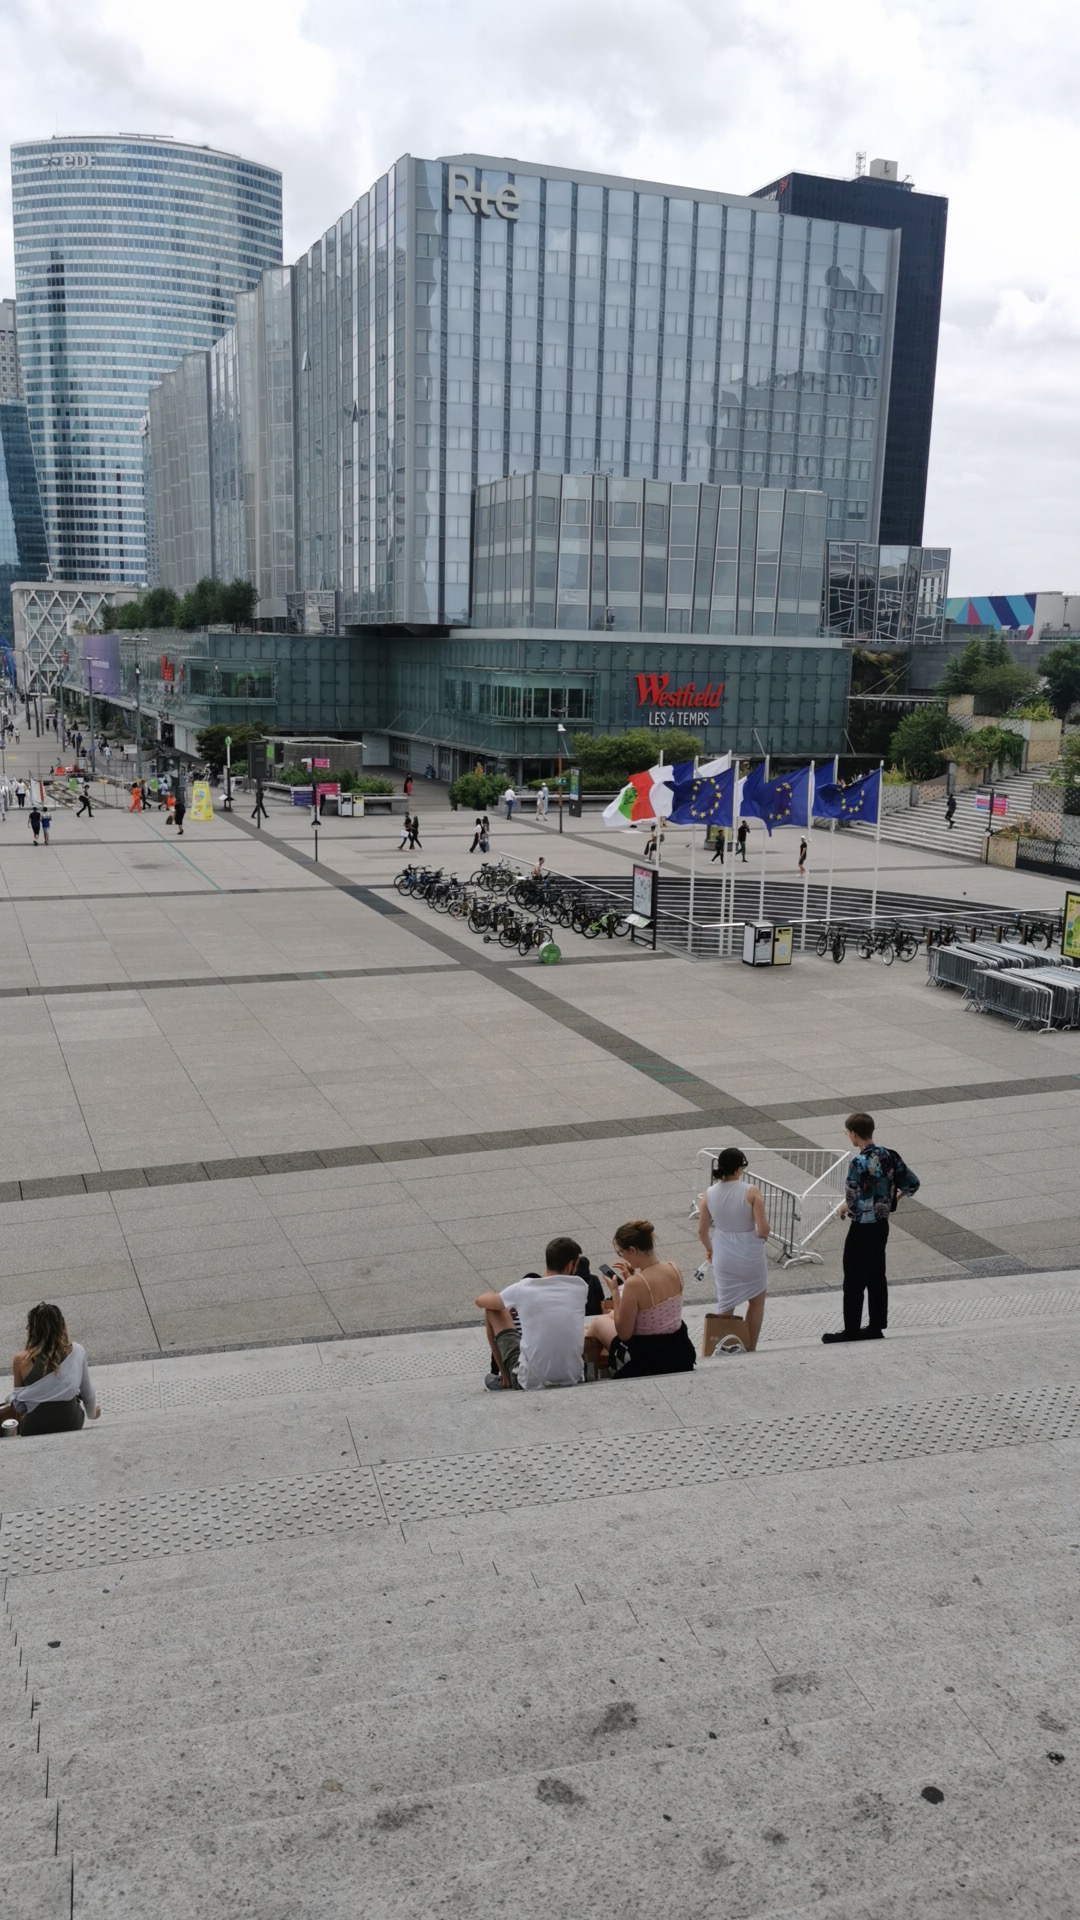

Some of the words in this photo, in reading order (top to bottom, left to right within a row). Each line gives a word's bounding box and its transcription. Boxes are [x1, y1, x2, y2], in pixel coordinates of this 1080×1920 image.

[448, 166, 522, 220] Rte
[635, 672, 726, 708] Westfield
[649, 711, 666, 726] LES
[668, 712, 675, 725] 4
[677, 711, 710, 726] TEMPS
